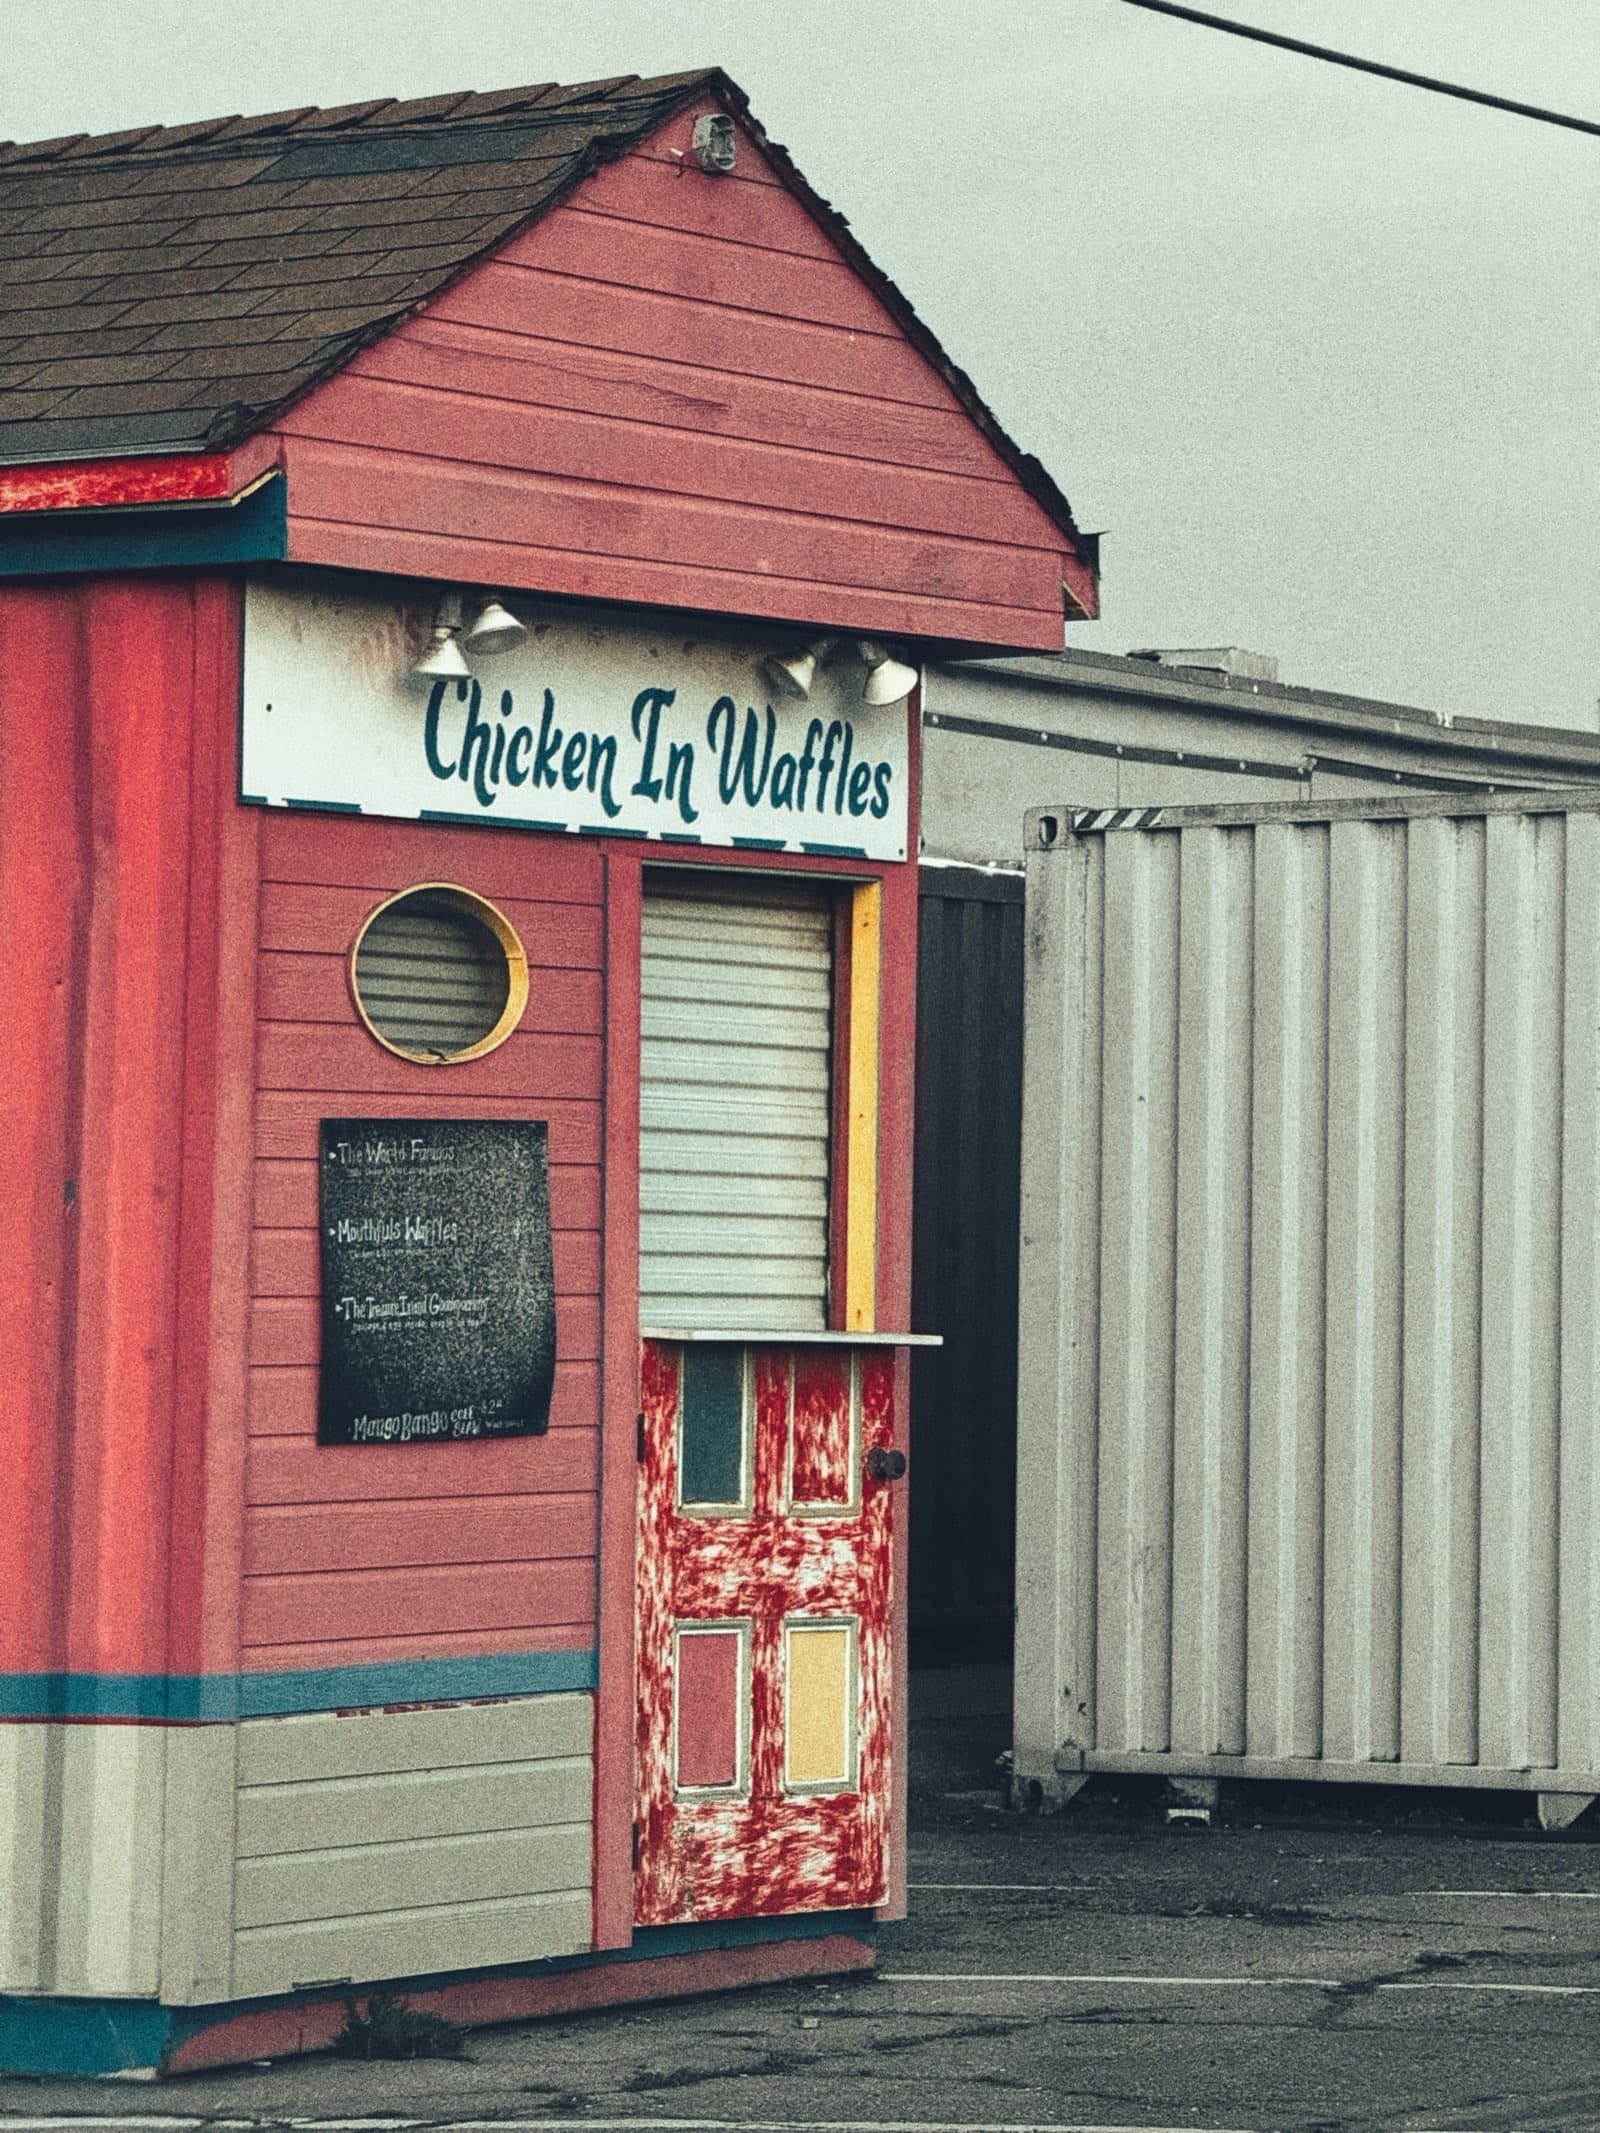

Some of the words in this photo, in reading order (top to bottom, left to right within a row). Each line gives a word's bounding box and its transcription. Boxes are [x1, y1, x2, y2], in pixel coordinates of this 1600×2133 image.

[424, 676, 622, 819] Chicken
[631, 687, 699, 824] In
[706, 695, 893, 820] Waffles
[352, 1412, 400, 1440] Mango
[401, 1411, 449, 1440] Bango
